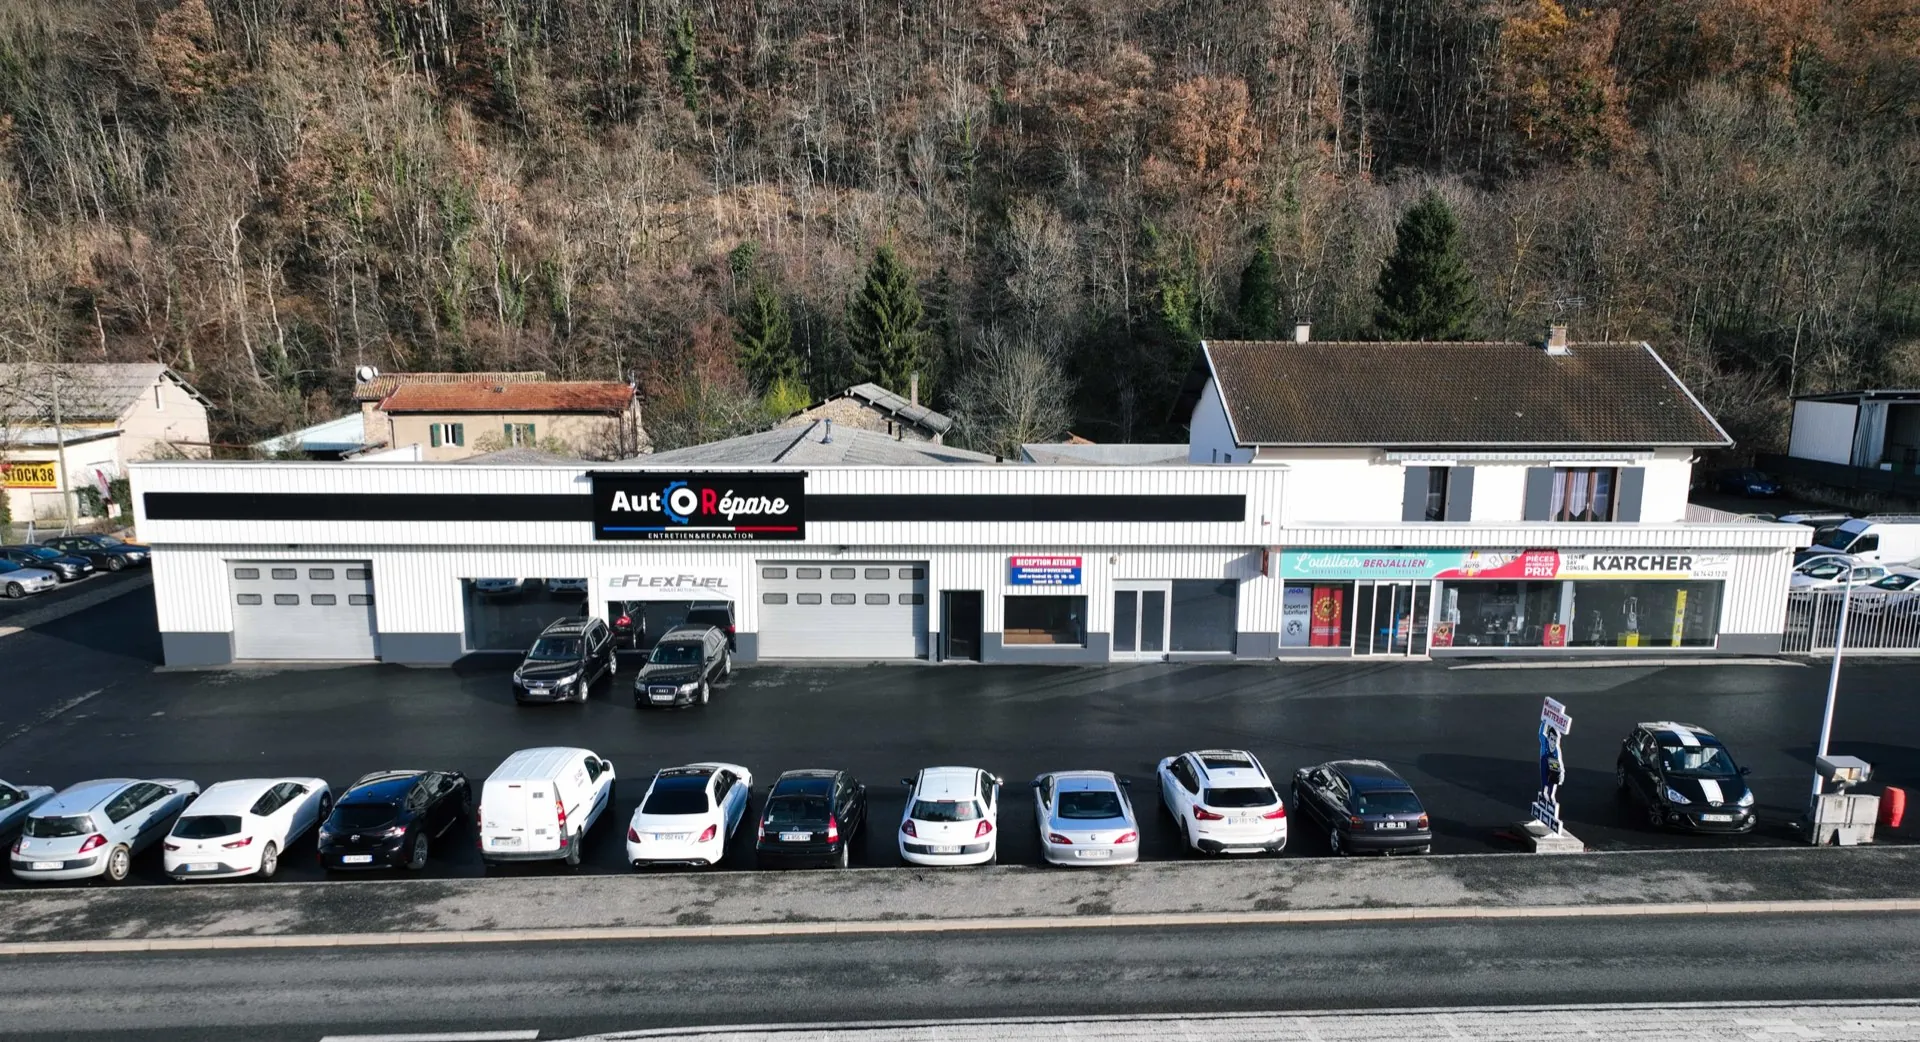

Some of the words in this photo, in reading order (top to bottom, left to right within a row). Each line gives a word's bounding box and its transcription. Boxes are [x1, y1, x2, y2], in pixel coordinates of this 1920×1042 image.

[701, 488, 790, 521] Répare
[1363, 559, 1427, 568] BERJALLIEN
[1525, 554, 1555, 563] PIÈCES
[1592, 556, 1693, 571] KÄRCHER
[1524, 567, 1553, 577] PRIX
